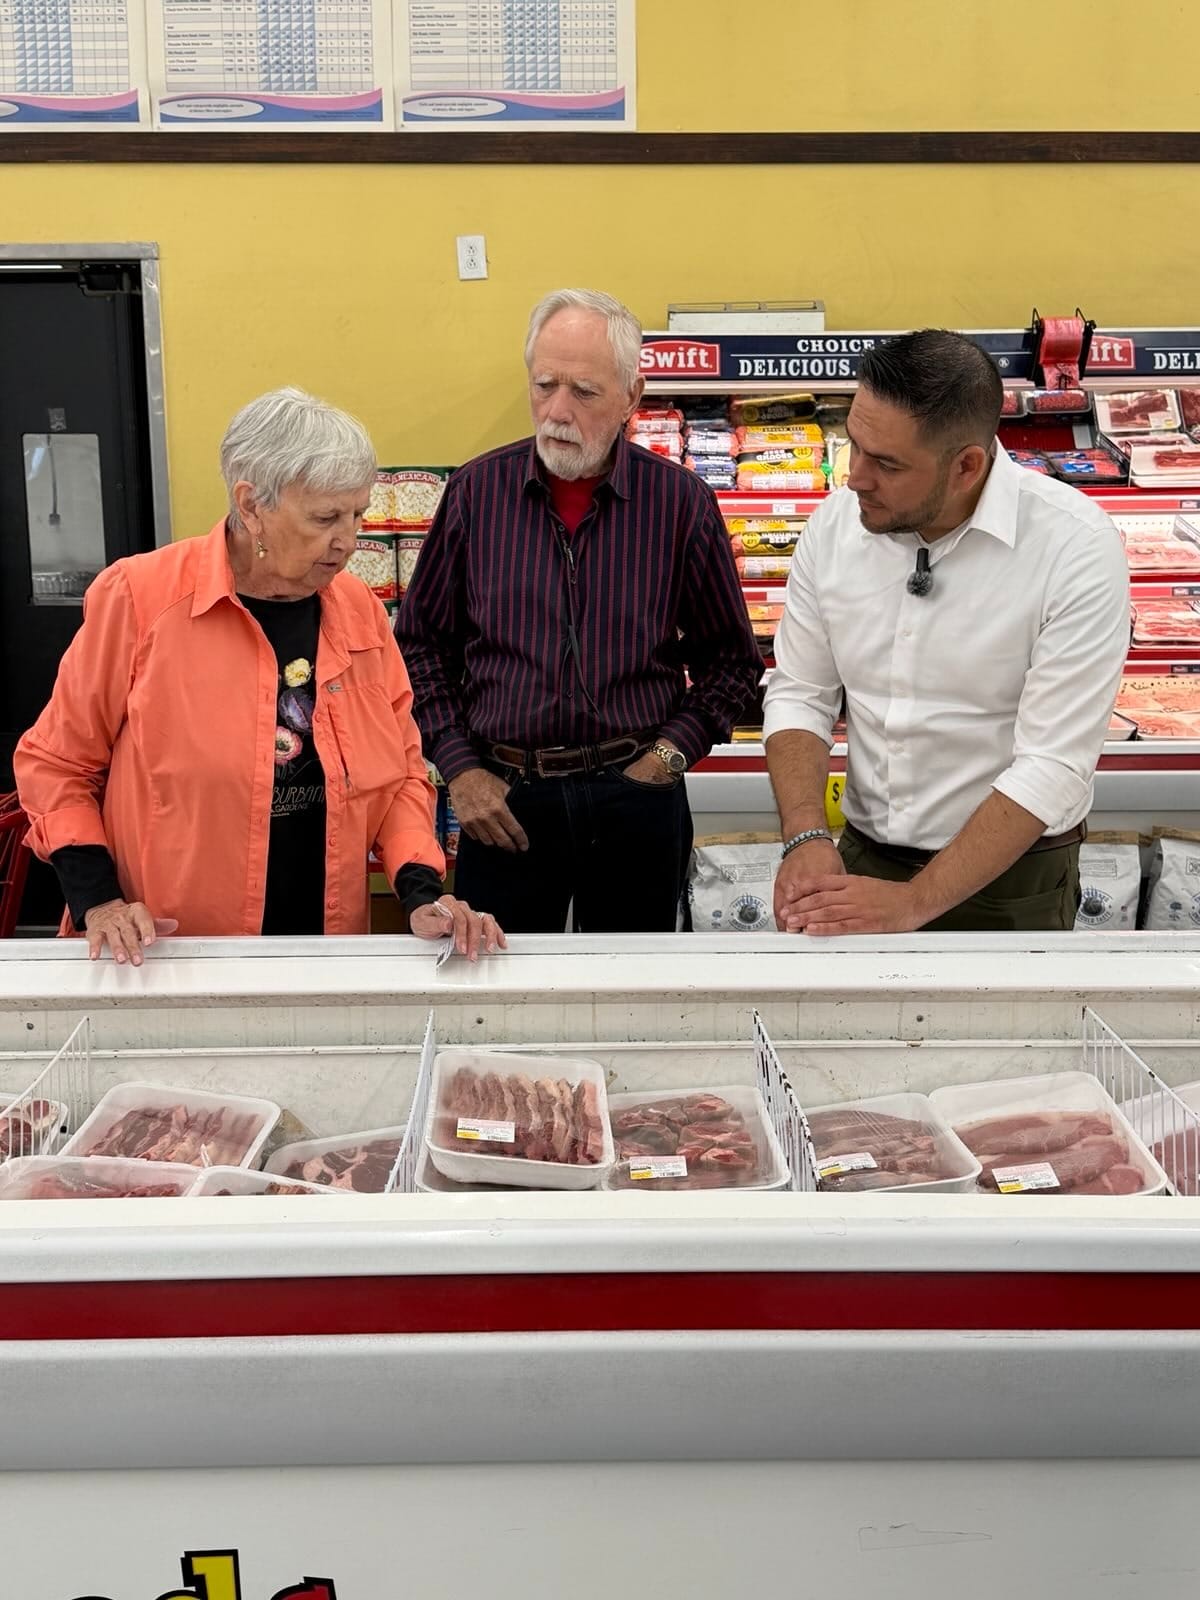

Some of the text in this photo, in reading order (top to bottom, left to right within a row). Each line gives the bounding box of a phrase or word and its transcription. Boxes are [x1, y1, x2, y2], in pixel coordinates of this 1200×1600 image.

[796, 339, 875, 352] CHOICE
[1091, 341, 1124, 361] ift
[639, 346, 709, 368] Swift
[738, 359, 857, 376] DELICIOUS.
